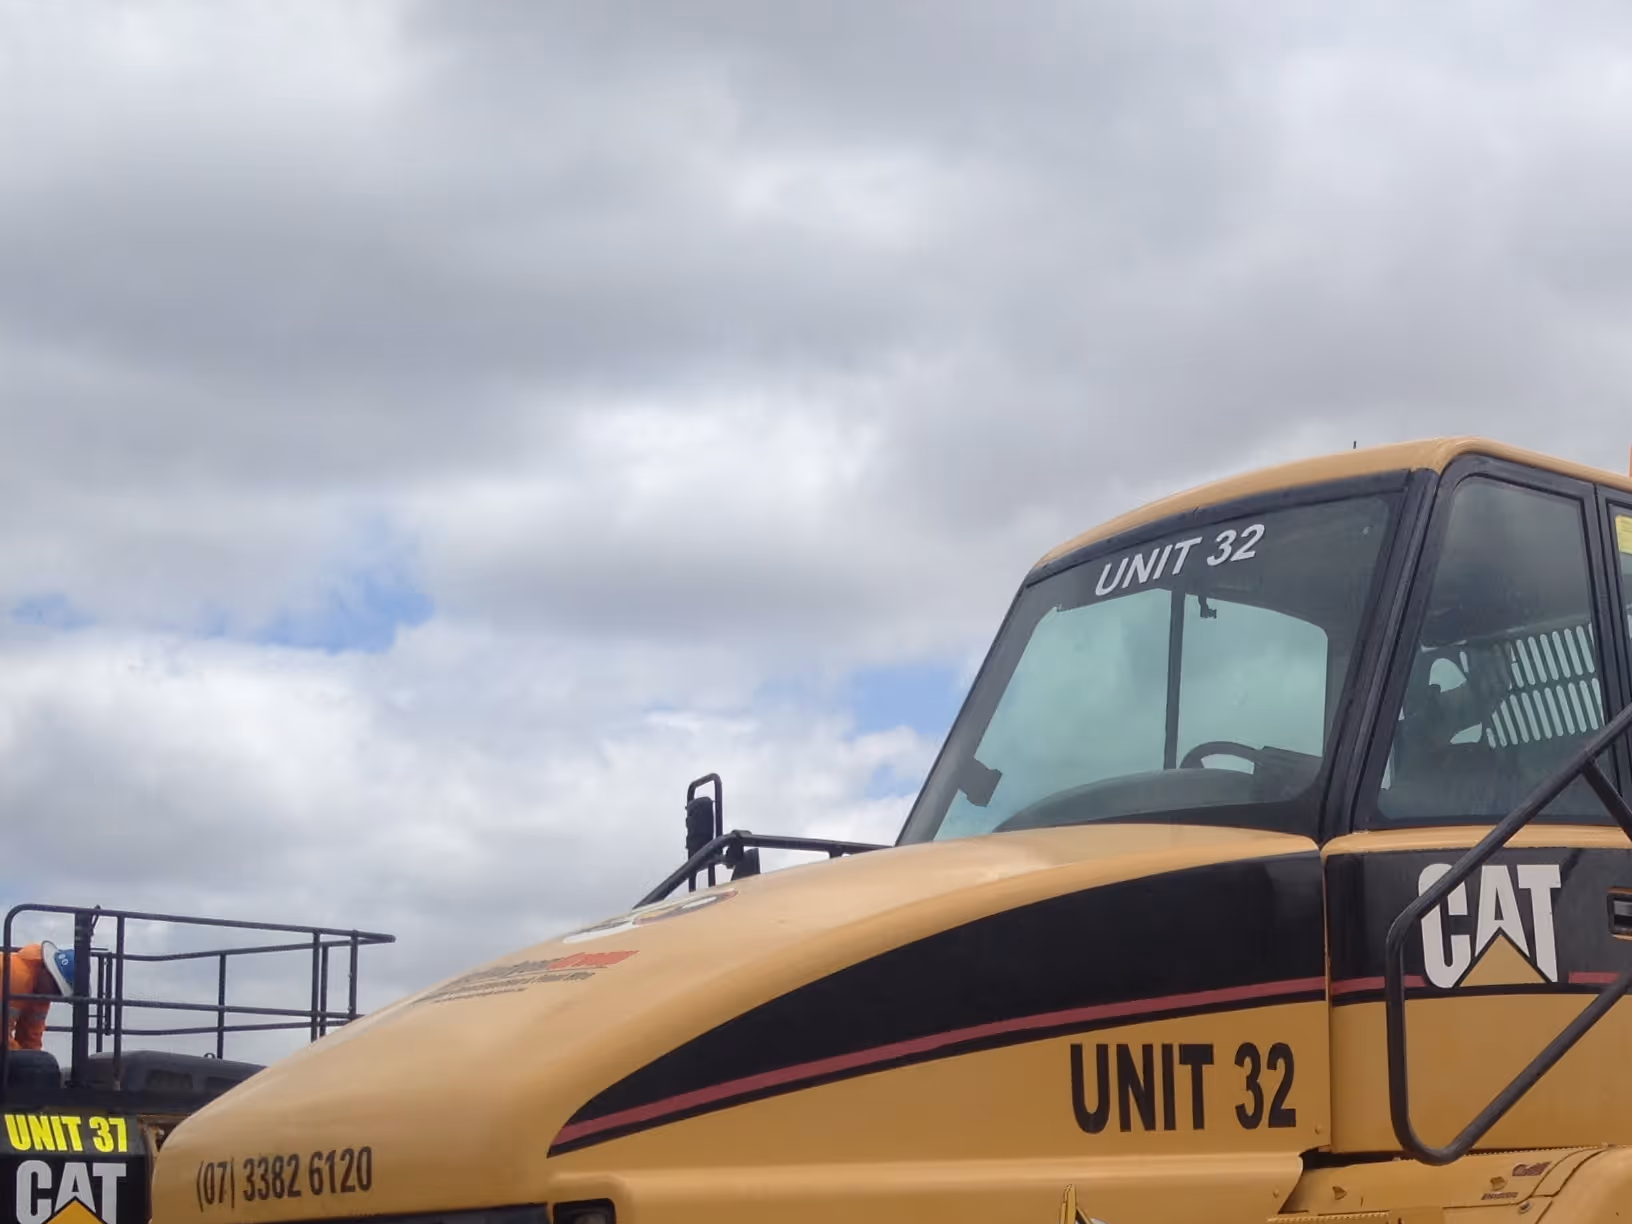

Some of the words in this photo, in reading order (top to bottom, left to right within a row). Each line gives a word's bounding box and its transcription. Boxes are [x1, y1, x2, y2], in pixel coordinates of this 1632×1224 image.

[1095, 536, 1203, 596] UNIT
[1206, 524, 1265, 566] 32
[1418, 863, 1561, 988] CAT
[1070, 1043, 1214, 1134] UNIT
[1234, 1042, 1297, 1130] 32
[4, 1114, 83, 1151] UNIT
[89, 1116, 128, 1152] 37
[196, 1157, 235, 1212] (07)
[242, 1154, 302, 1201] 3382
[309, 1146, 373, 1195] 6120
